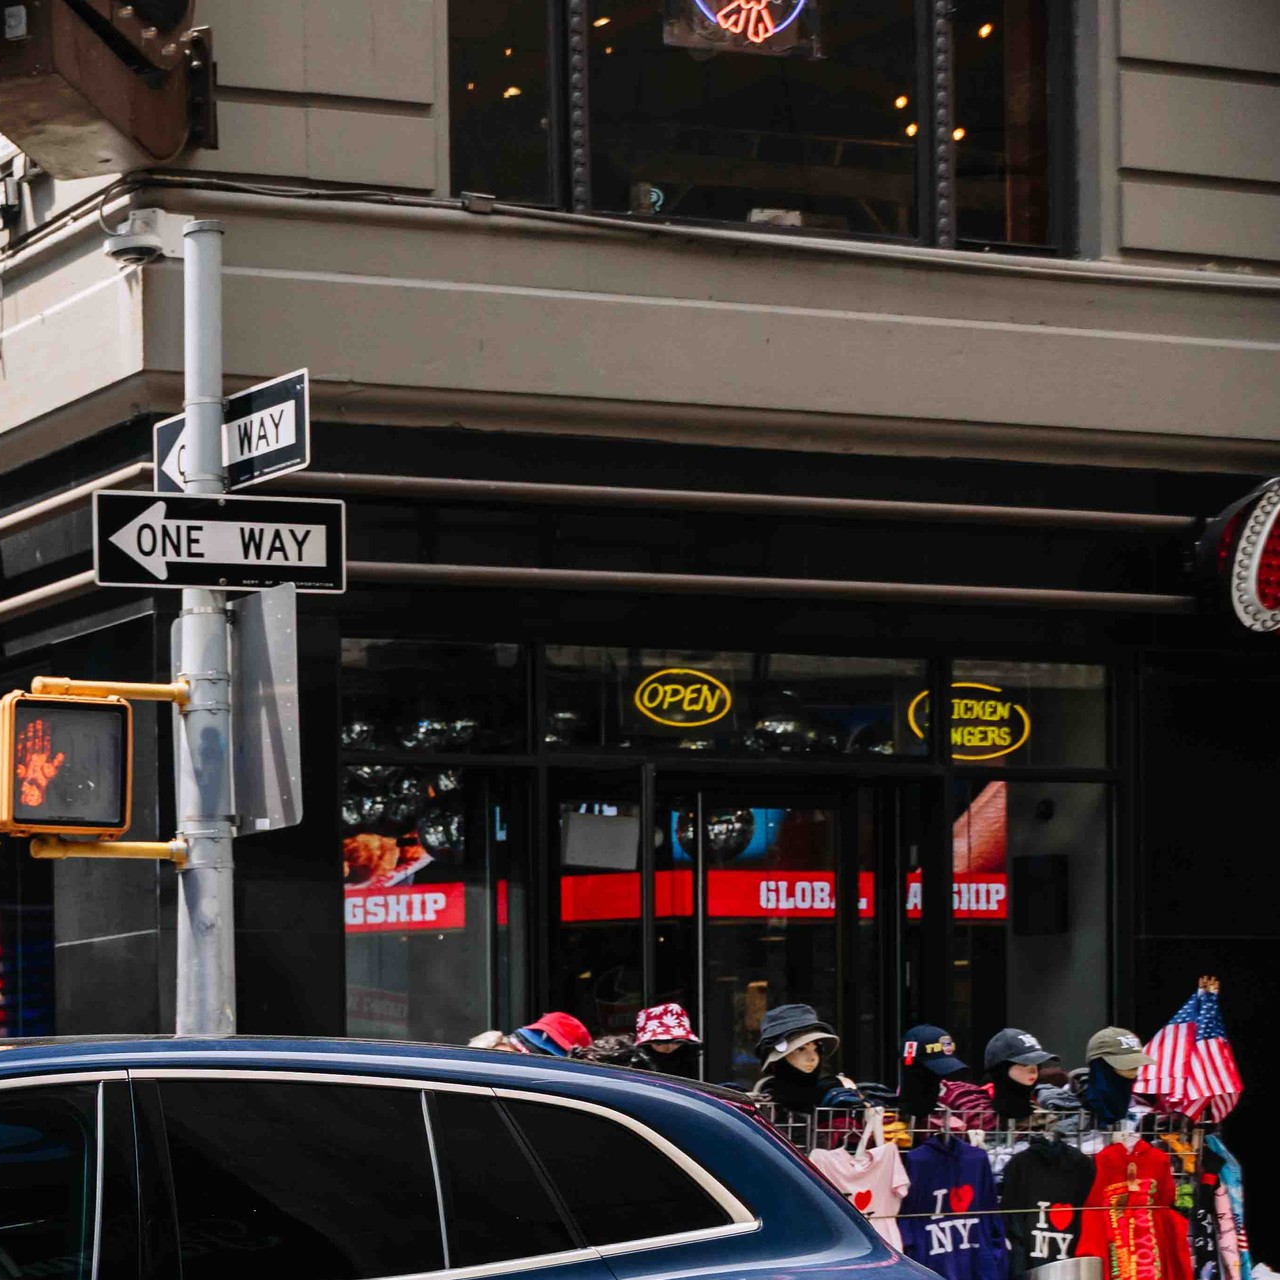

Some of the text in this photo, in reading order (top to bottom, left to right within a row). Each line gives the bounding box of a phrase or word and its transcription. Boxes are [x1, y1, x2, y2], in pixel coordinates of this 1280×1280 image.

[237, 409, 284, 456] WAY
[136, 523, 312, 562] ONE WAY
[643, 683, 722, 714] OPEN
[952, 700, 1011, 721] ICKEN
[952, 726, 1012, 746] NGERS
[344, 892, 446, 925] GSHIP
[931, 1188, 948, 1220] I
[1036, 1201, 1051, 1229] I
[925, 1217, 979, 1256] NY
[1029, 1230, 1073, 1260] NY
